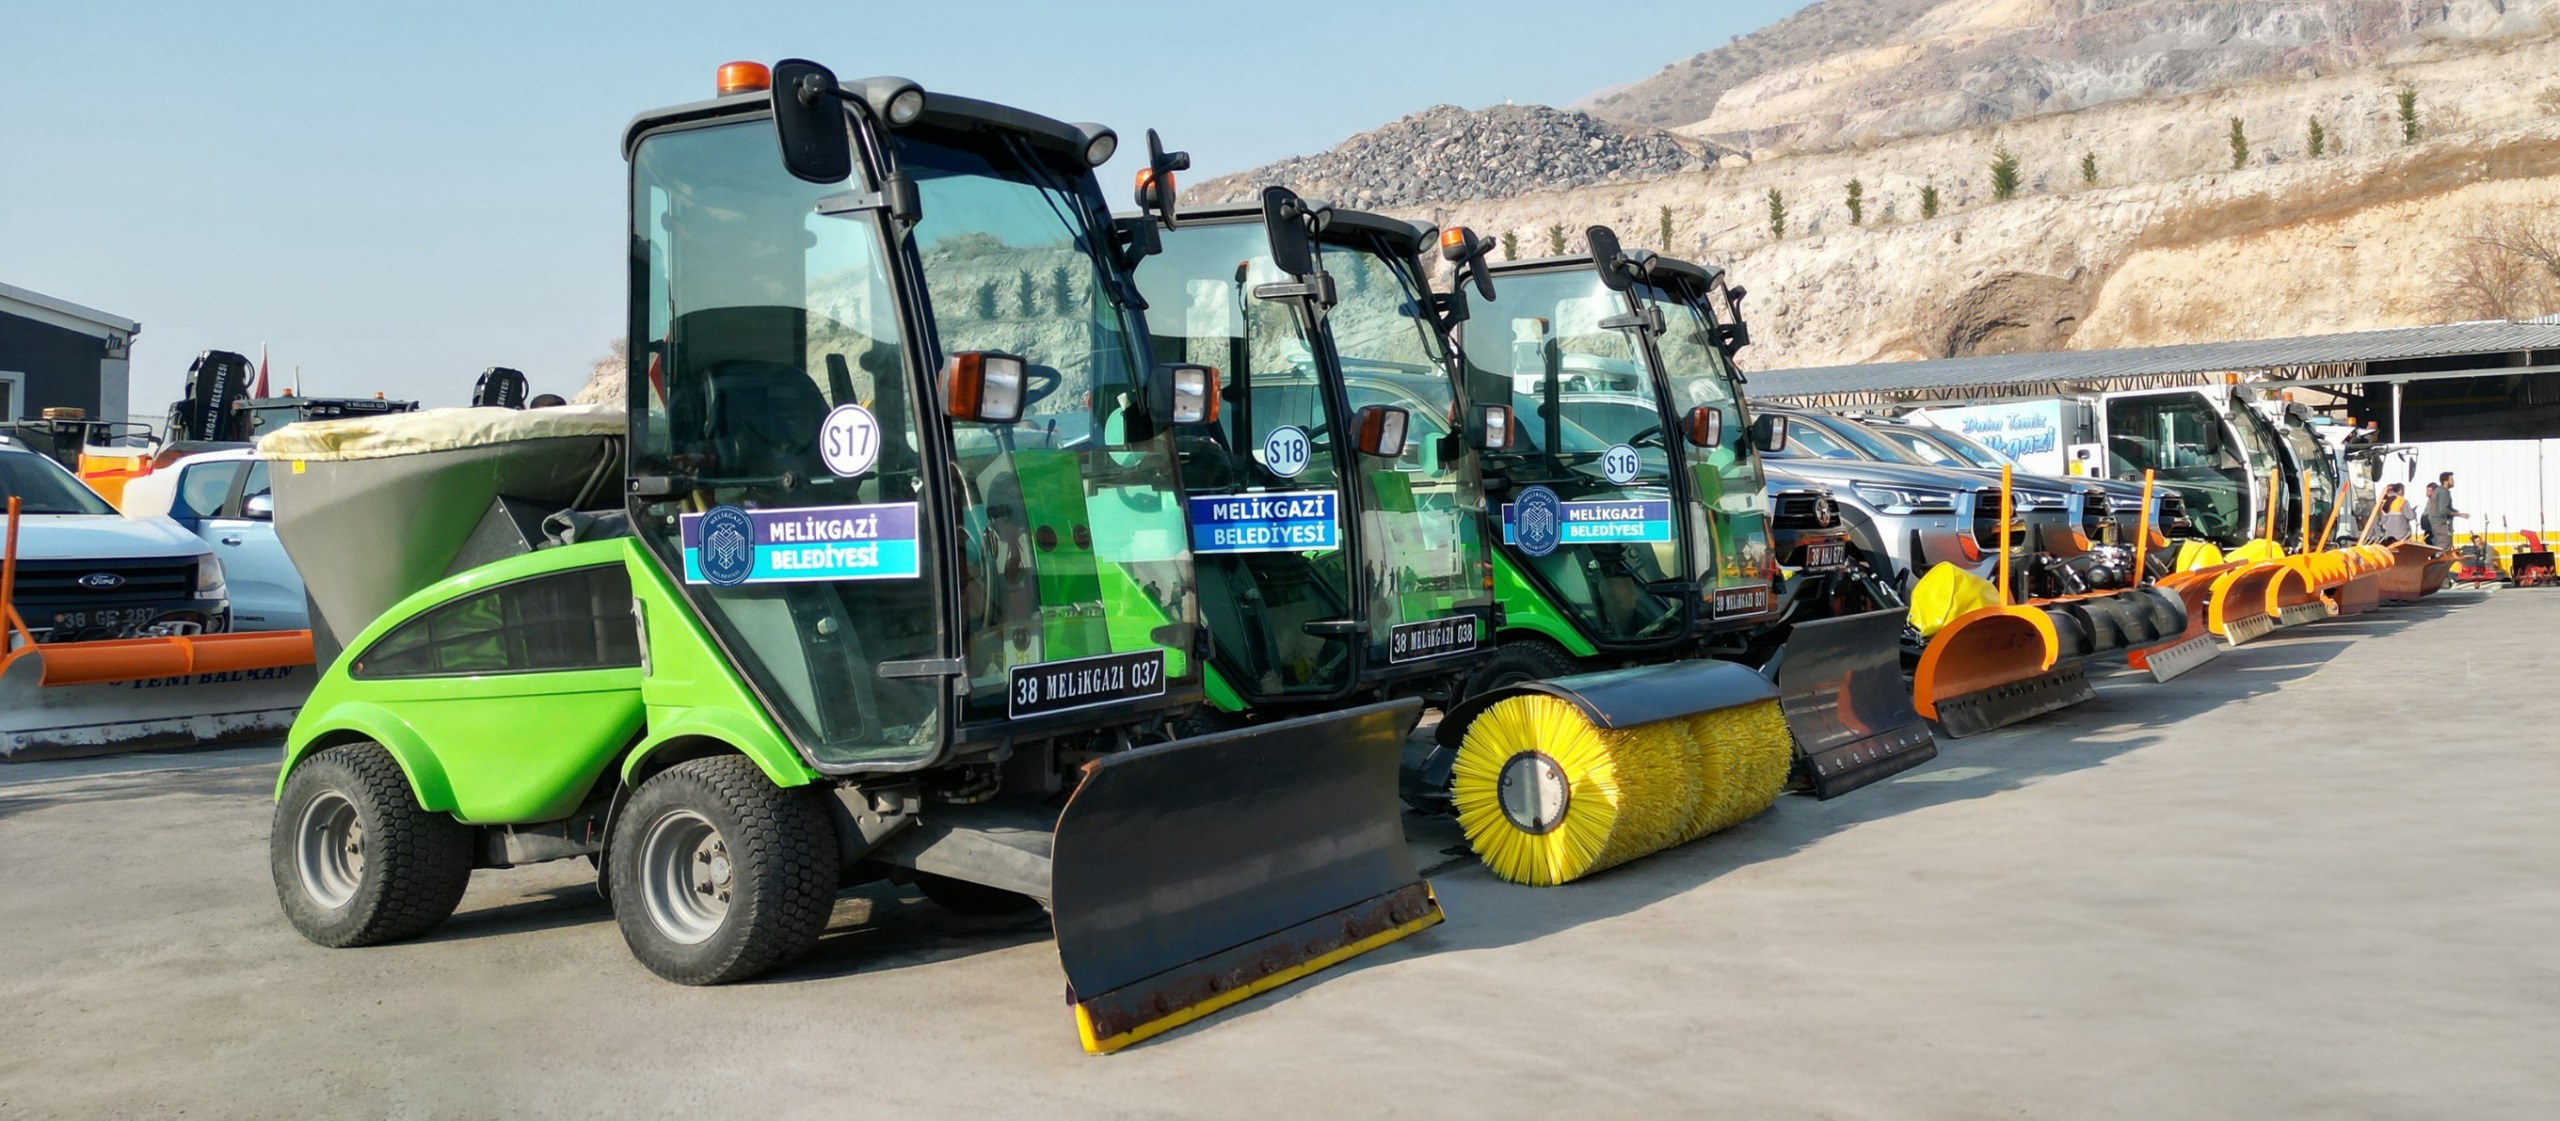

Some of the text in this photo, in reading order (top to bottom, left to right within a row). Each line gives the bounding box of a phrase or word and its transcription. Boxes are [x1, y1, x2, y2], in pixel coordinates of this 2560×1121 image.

[829, 424, 870, 458] S17
[1270, 439, 1304, 464] S18
[1607, 454, 1636, 475] S16
[1213, 495, 1325, 520] MELİKGAZİ
[1569, 505, 1645, 521] MELİKGAZİ
[770, 513, 879, 542] MELİKGAZİ
[1214, 521, 1325, 545] BELEDİYESİ
[1570, 523, 1645, 537] BELEDİYESİ
[771, 542, 879, 570] BELEDİYESİ
[90, 574, 116, 585] Ford
[65, 612, 86, 628] 38
[1394, 633, 1407, 653] 38
[1457, 623, 1473, 643] 038
[1017, 677, 1038, 705] 38
[1132, 660, 1159, 688] 037
